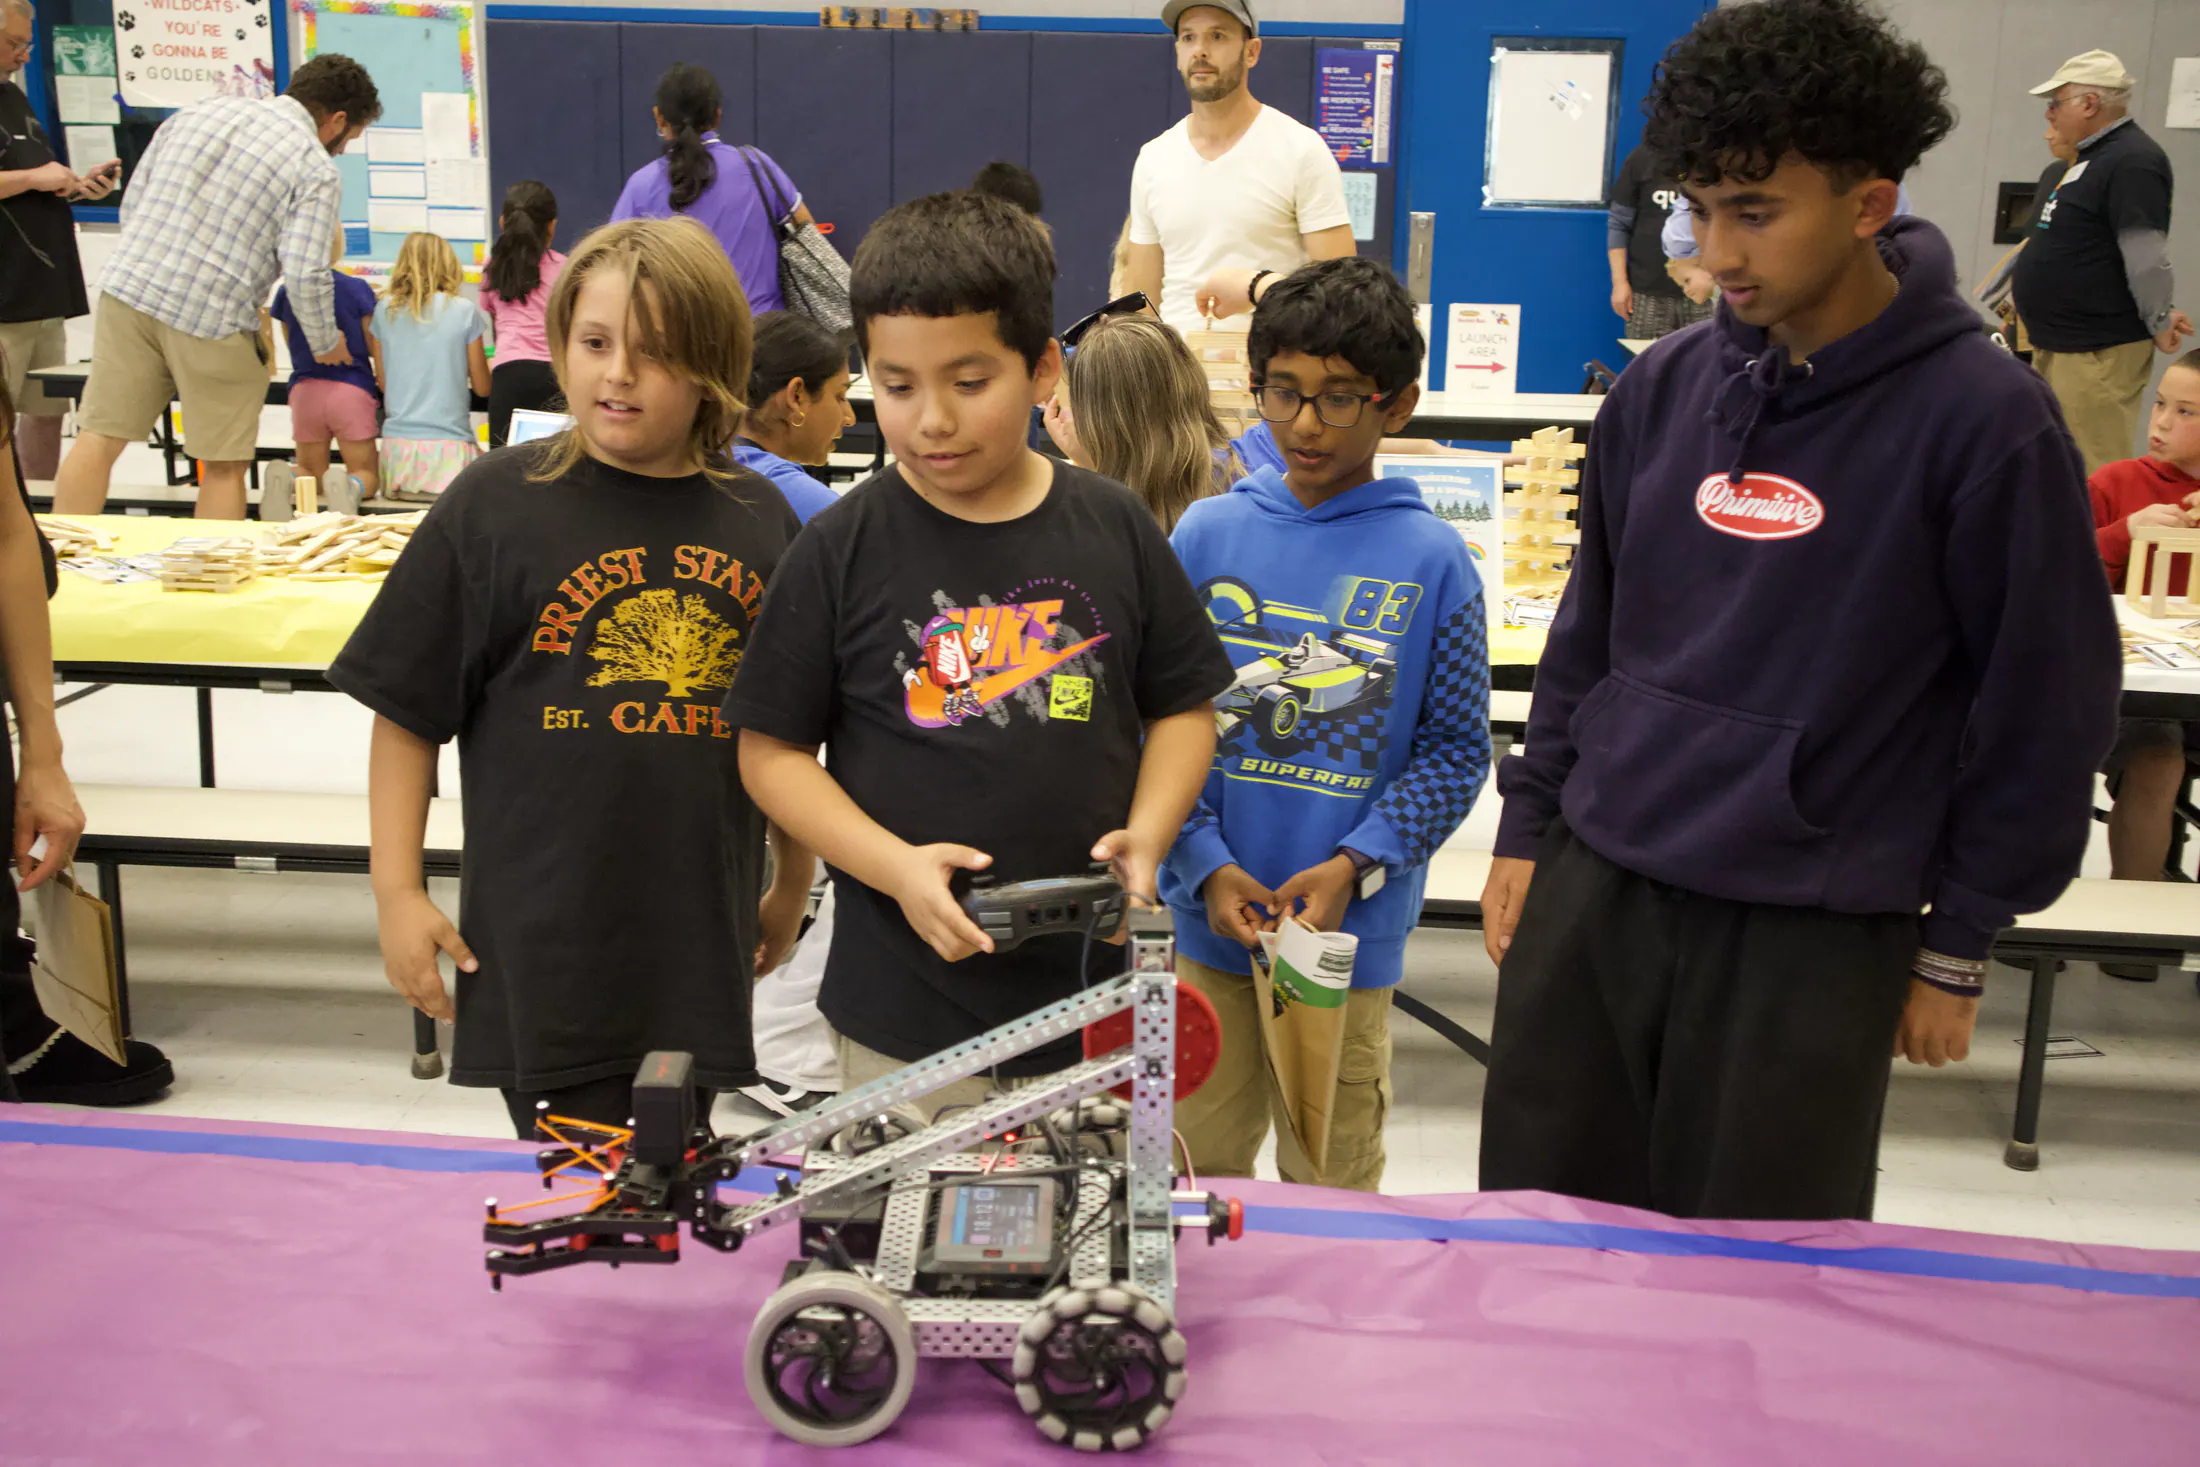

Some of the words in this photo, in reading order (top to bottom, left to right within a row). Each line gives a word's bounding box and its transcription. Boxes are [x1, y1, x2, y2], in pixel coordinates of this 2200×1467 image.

[152, 0, 233, 13] WILDCATS
[165, 20, 222, 37] YOU'RE
[152, 43, 206, 58] GONNA
[211, 46, 229, 59] BE
[1459, 333, 1508, 344] LAUNCH
[1468, 346, 1497, 357] AREA
[1698, 478, 1819, 526] Primitive
[532, 546, 648, 656] PRIEST
[1341, 577, 1424, 636] 83
[936, 634, 959, 678] NIKE
